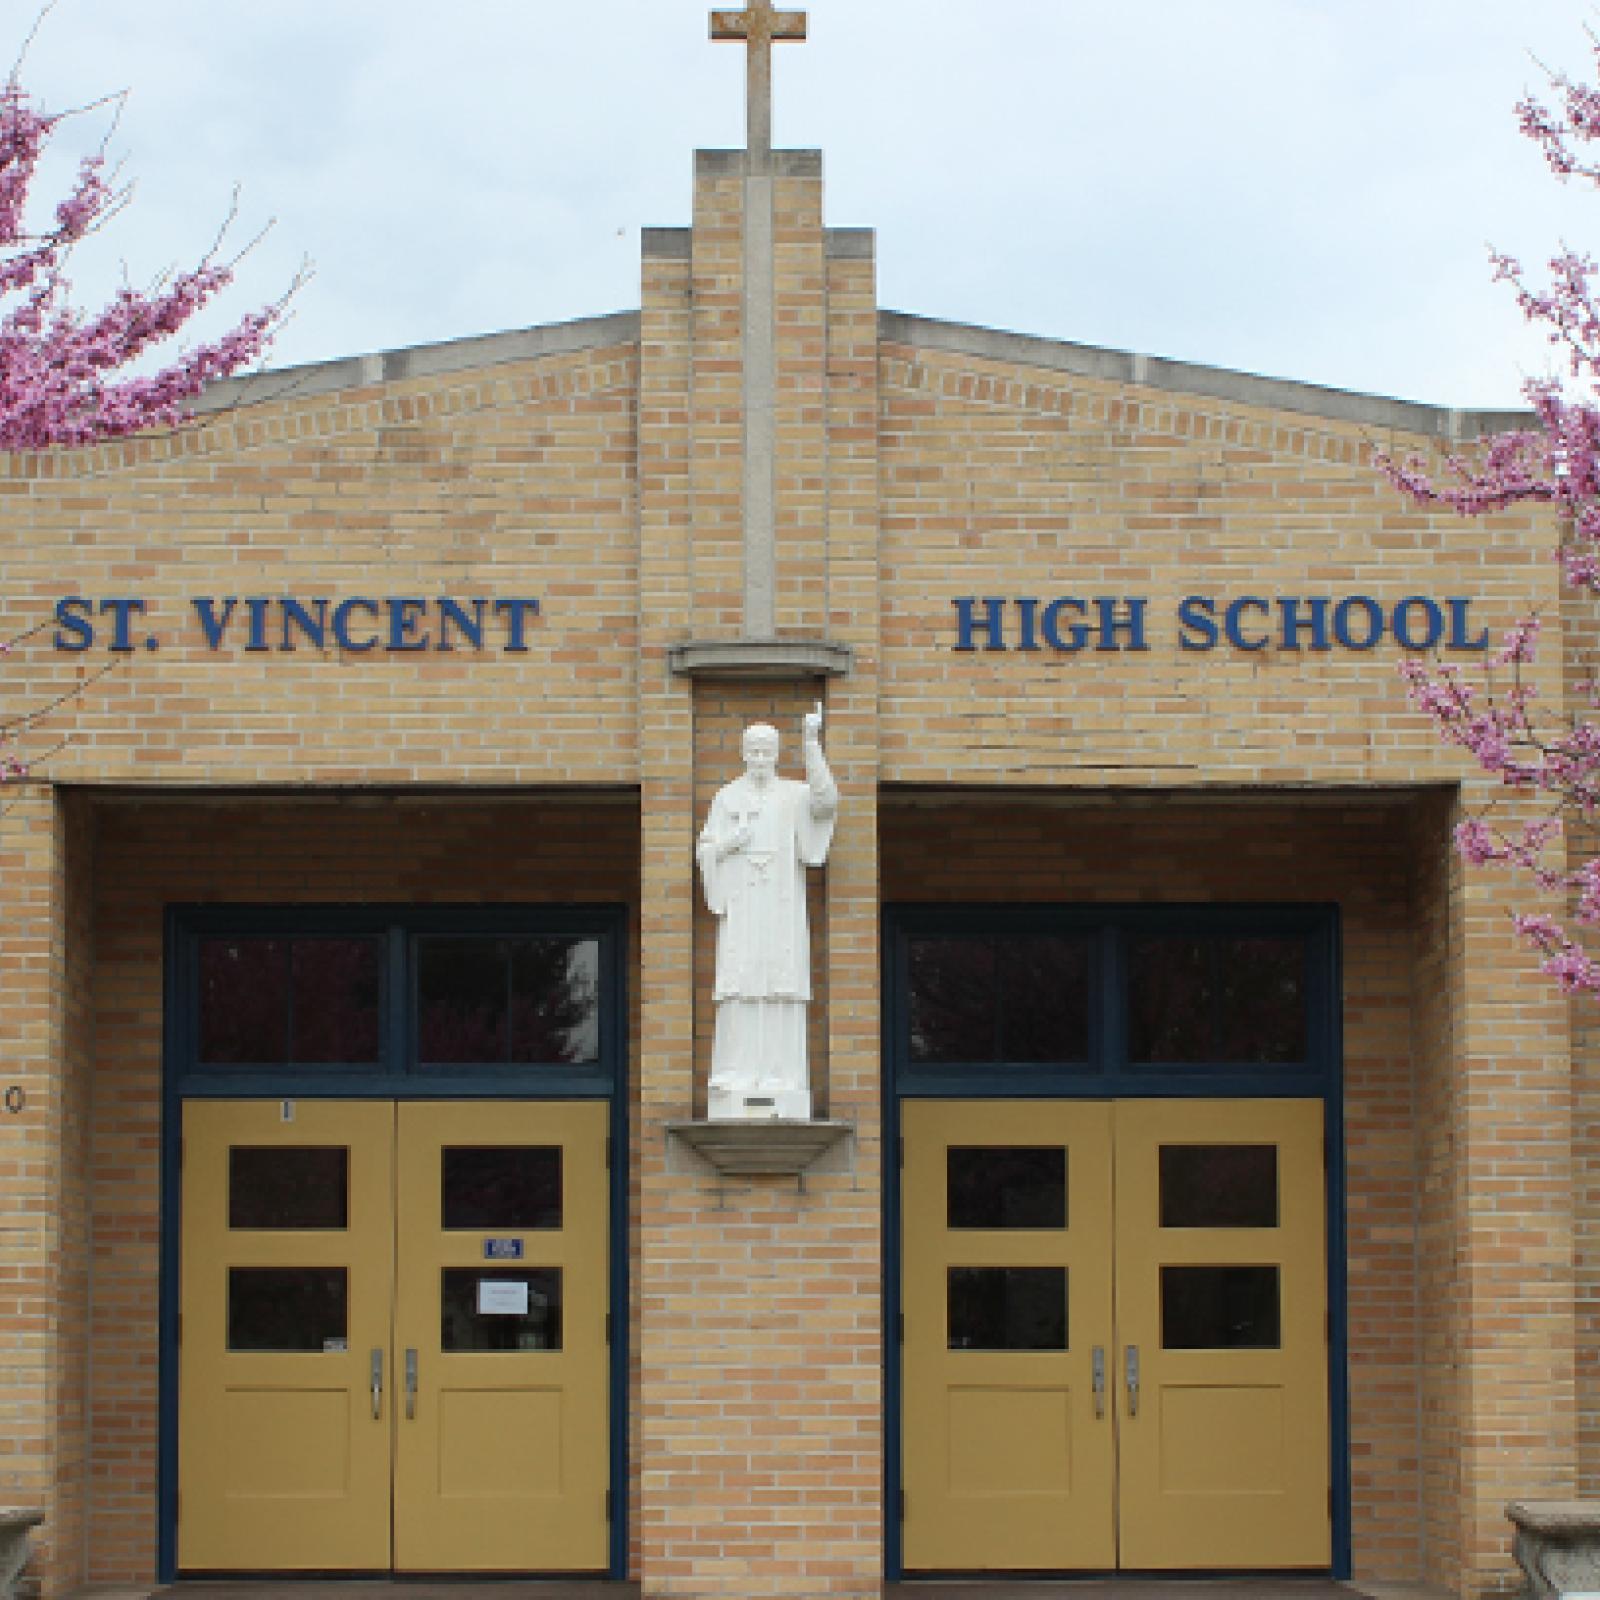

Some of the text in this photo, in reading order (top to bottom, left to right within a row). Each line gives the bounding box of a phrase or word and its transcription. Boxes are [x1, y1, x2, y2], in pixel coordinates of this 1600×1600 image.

[54, 595, 1489, 652] ST. VINCENT HIGH SCHOOL
